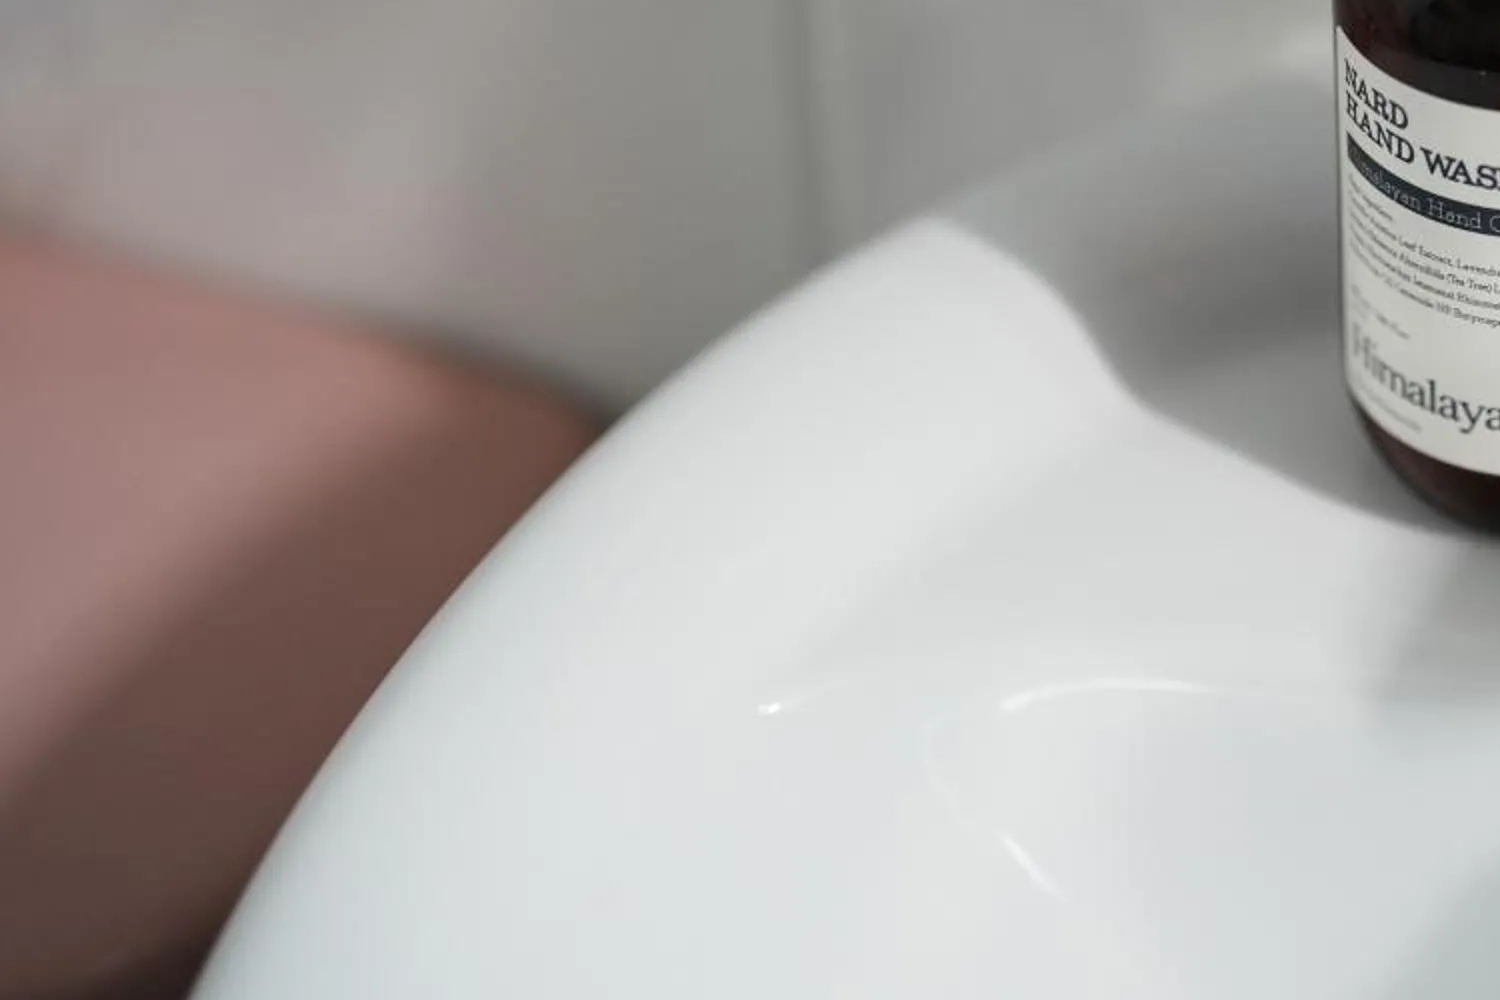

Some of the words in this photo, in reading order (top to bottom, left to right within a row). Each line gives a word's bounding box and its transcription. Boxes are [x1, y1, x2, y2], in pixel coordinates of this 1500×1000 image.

[1344, 57, 1409, 130] NARD
[1345, 88, 1415, 164] HAND
[1428, 198, 1482, 231] Hand
